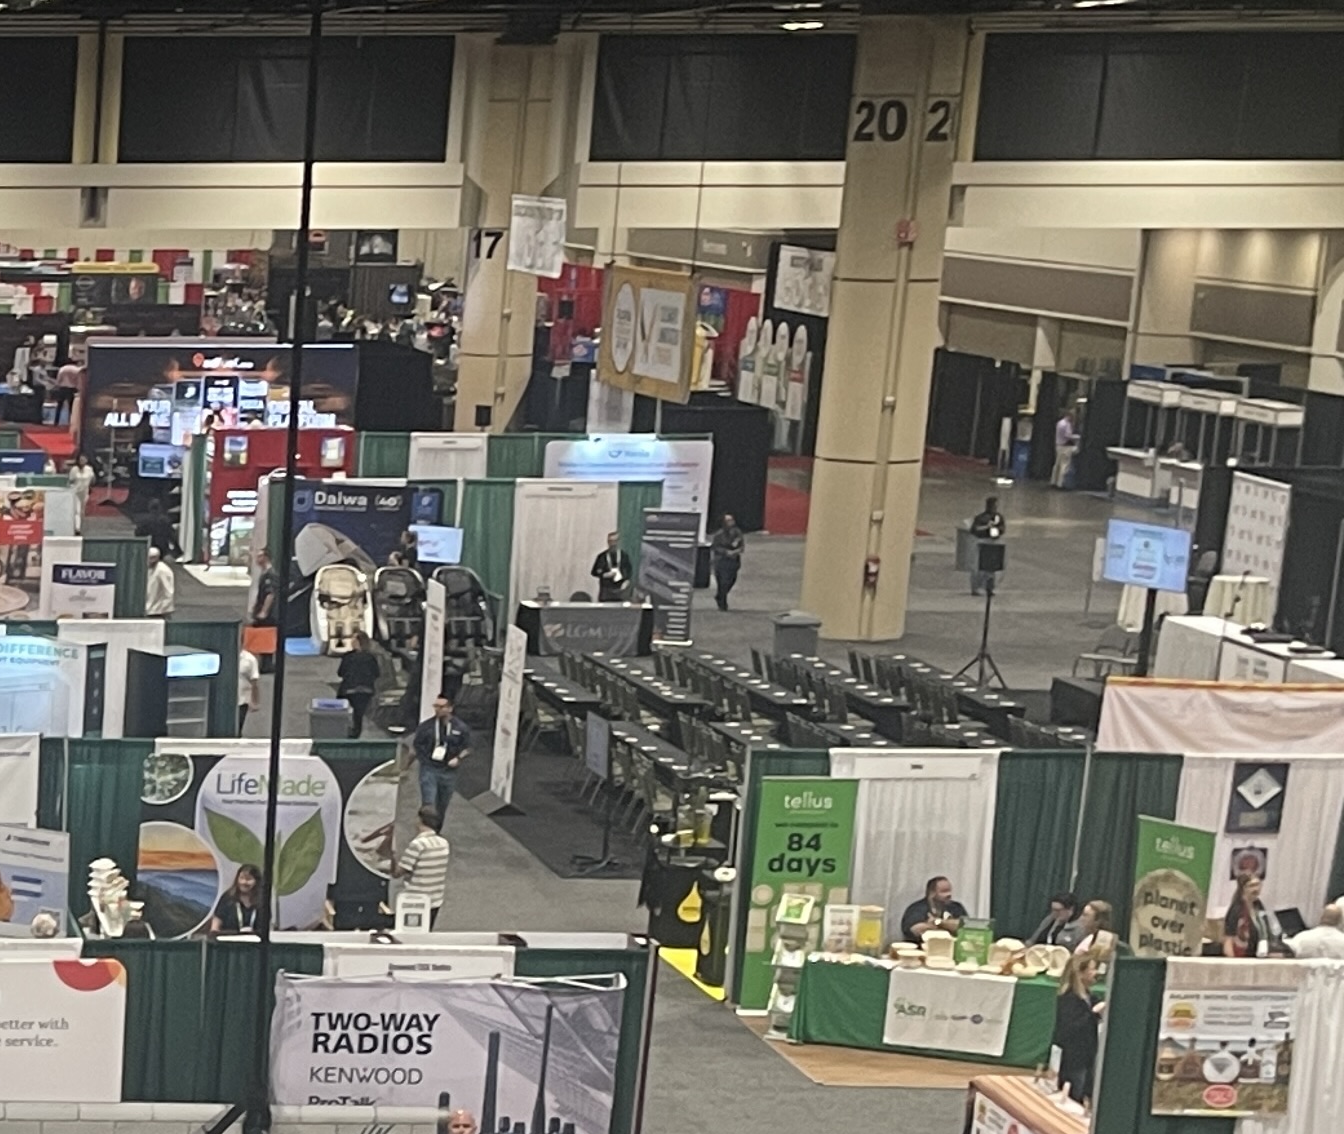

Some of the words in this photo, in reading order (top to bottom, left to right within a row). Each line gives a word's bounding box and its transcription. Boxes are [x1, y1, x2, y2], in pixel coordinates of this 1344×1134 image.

[853, 101, 907, 142] 20
[473, 230, 503, 259] 17
[313, 490, 368, 507] Daiwa
[61, 568, 107, 580] FLAVOR
[784, 791, 833, 811] tellus
[787, 832, 822, 852] 84
[1155, 835, 1195, 860] tellus
[767, 853, 837, 877] days
[1143, 888, 1197, 917] planet
[1151, 914, 1185, 934] over
[1138, 933, 1192, 957] plastic
[37, 1017, 69, 1031] with
[310, 1012, 441, 1032] TWO-WAY
[5, 1034, 59, 1048] service.
[311, 1032, 433, 1055] RADIOS
[309, 1066, 423, 1086] KENWOOD
